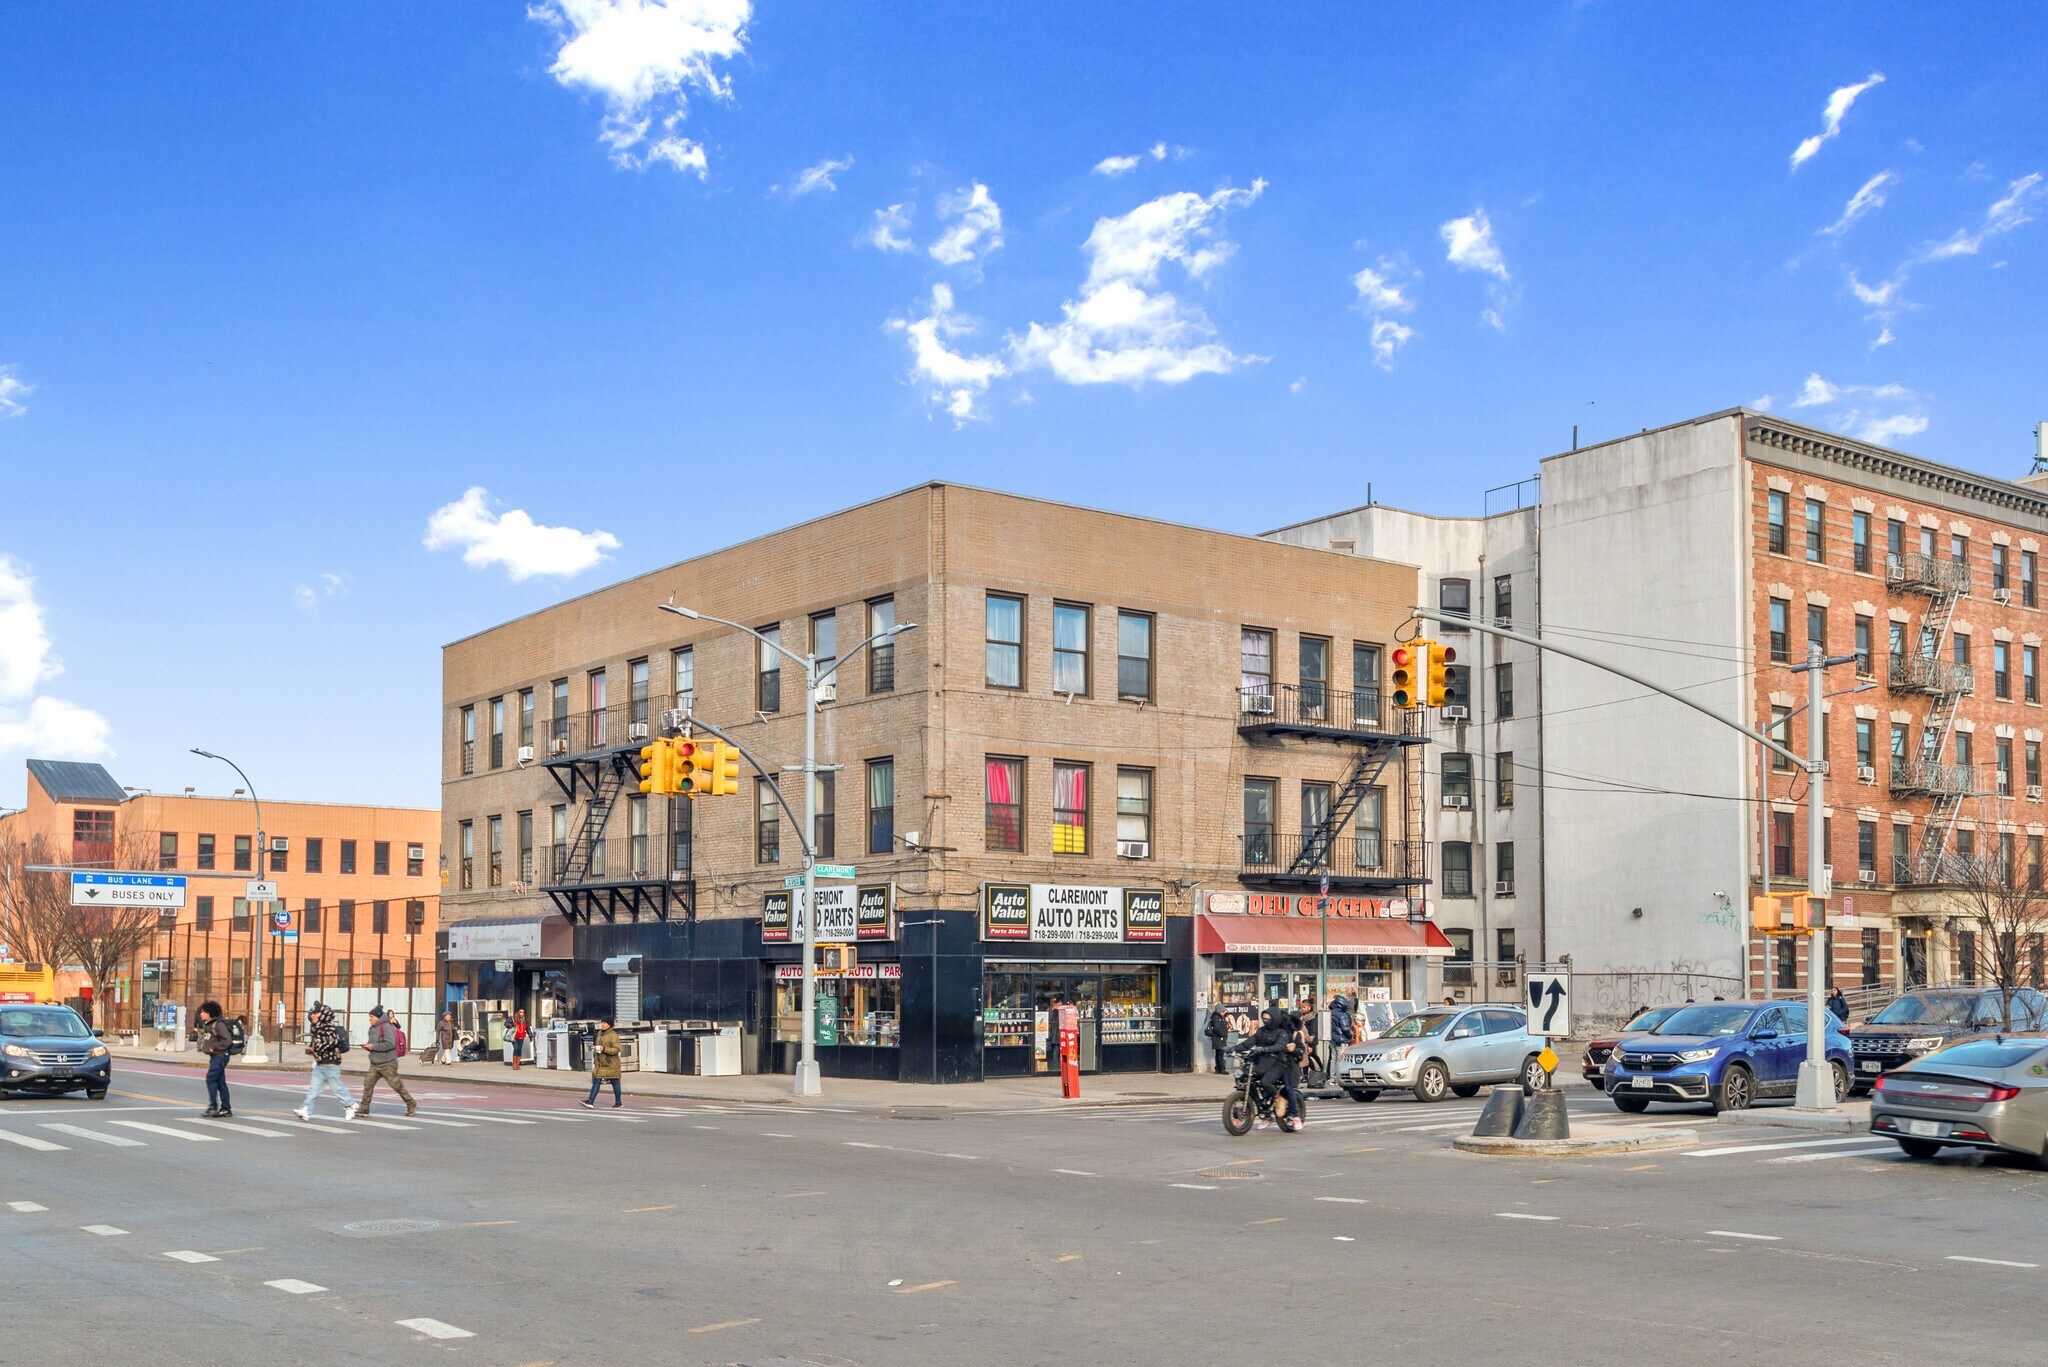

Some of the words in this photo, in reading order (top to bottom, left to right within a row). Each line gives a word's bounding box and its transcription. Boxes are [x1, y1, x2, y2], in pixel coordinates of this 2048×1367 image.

[817, 864, 853, 874] CLAREMONT
[107, 876, 124, 884] BUS
[131, 877, 152, 885] LANE
[112, 890, 145, 900] BUSES
[149, 892, 174, 901] ONLY
[861, 893, 884, 907] Auto
[993, 893, 1026, 906] Auto
[1048, 888, 1108, 905] CLAREMONT
[766, 898, 787, 911] Auto
[1131, 897, 1160, 910] Auto
[1248, 895, 1290, 915] DELI
[764, 910, 788, 923] Value
[824, 907, 854, 927] PARTS
[860, 906, 885, 919] Value
[991, 905, 1027, 919] Value
[1037, 908, 1073, 928] AUTO
[1077, 908, 1118, 928] PARTS
[1129, 909, 1162, 922] Value
[826, 928, 854, 938] 718-299-0004
[1034, 930, 1074, 939] 718-299-0001
[1079, 930, 1118, 940] 718-299-0004
[780, 967, 802, 977] AUTO
[848, 966, 873, 977] AUTO
[1373, 991, 1386, 1000] ICE
